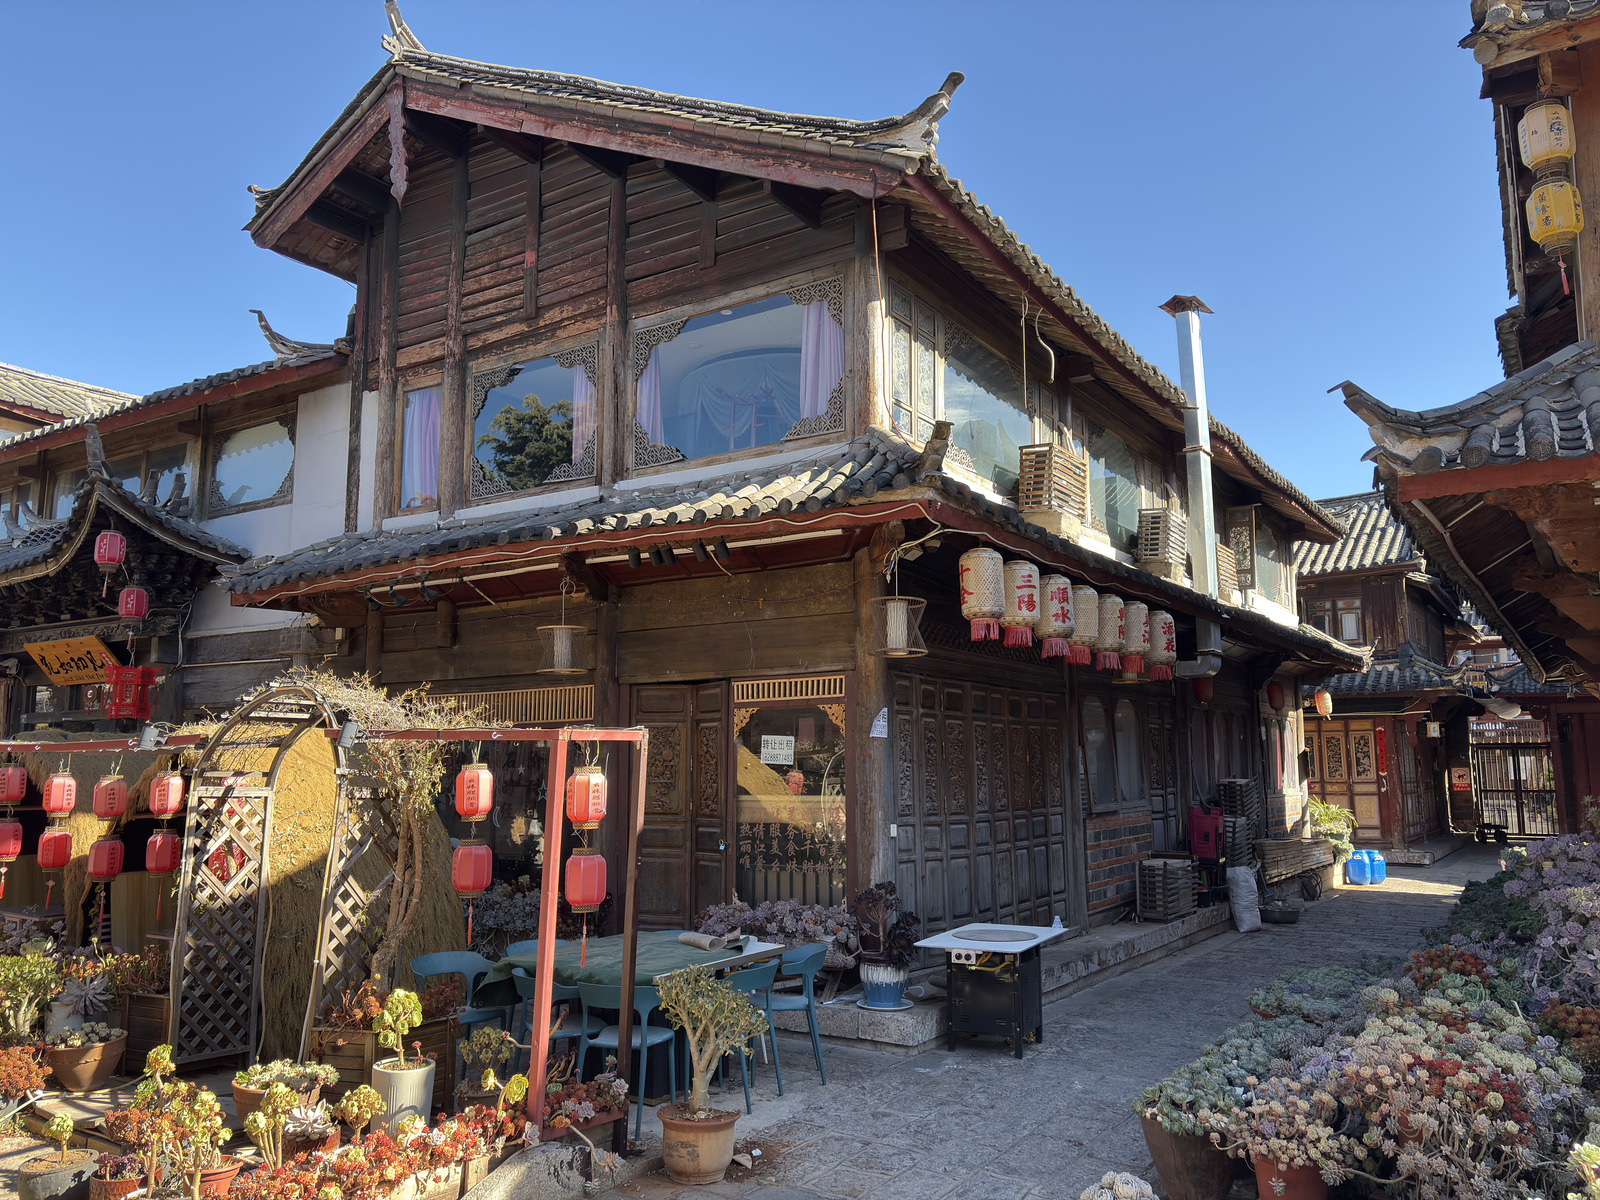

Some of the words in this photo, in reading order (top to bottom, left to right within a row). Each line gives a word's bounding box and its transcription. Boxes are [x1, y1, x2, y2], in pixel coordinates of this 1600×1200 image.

[1050, 587, 1071, 624] 順水
[763, 739, 792, 750] 转让出租
